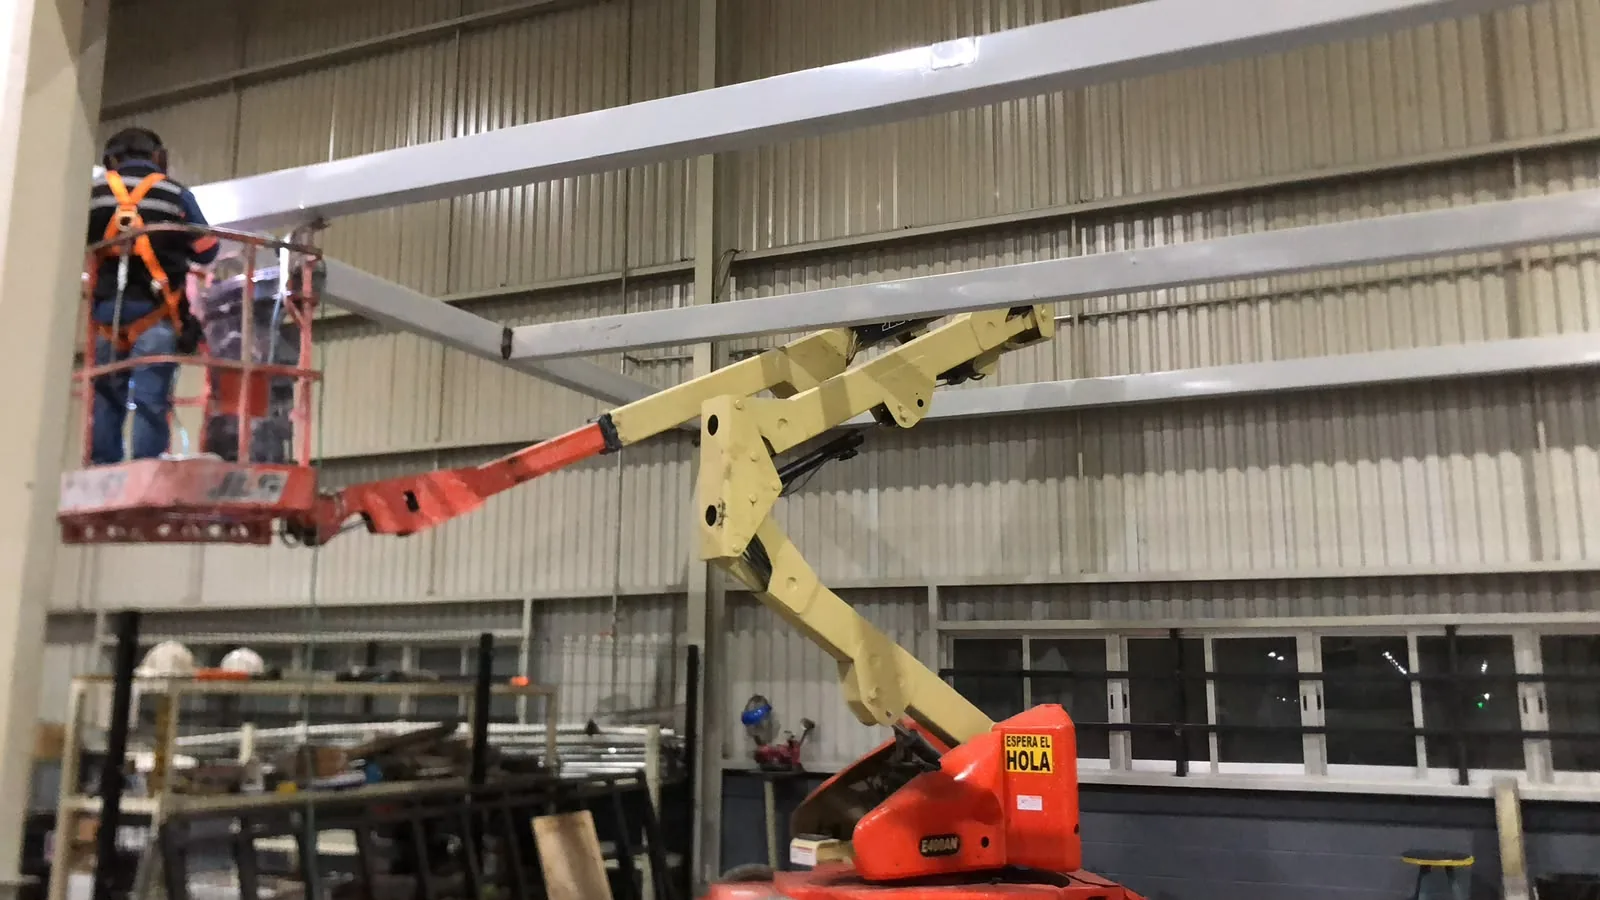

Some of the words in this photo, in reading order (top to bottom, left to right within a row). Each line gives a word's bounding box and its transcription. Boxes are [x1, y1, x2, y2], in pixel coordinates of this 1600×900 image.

[1006, 735, 1038, 748] ESPERA
[1040, 736, 1051, 748] EL
[1006, 750, 1050, 771] HOLA
